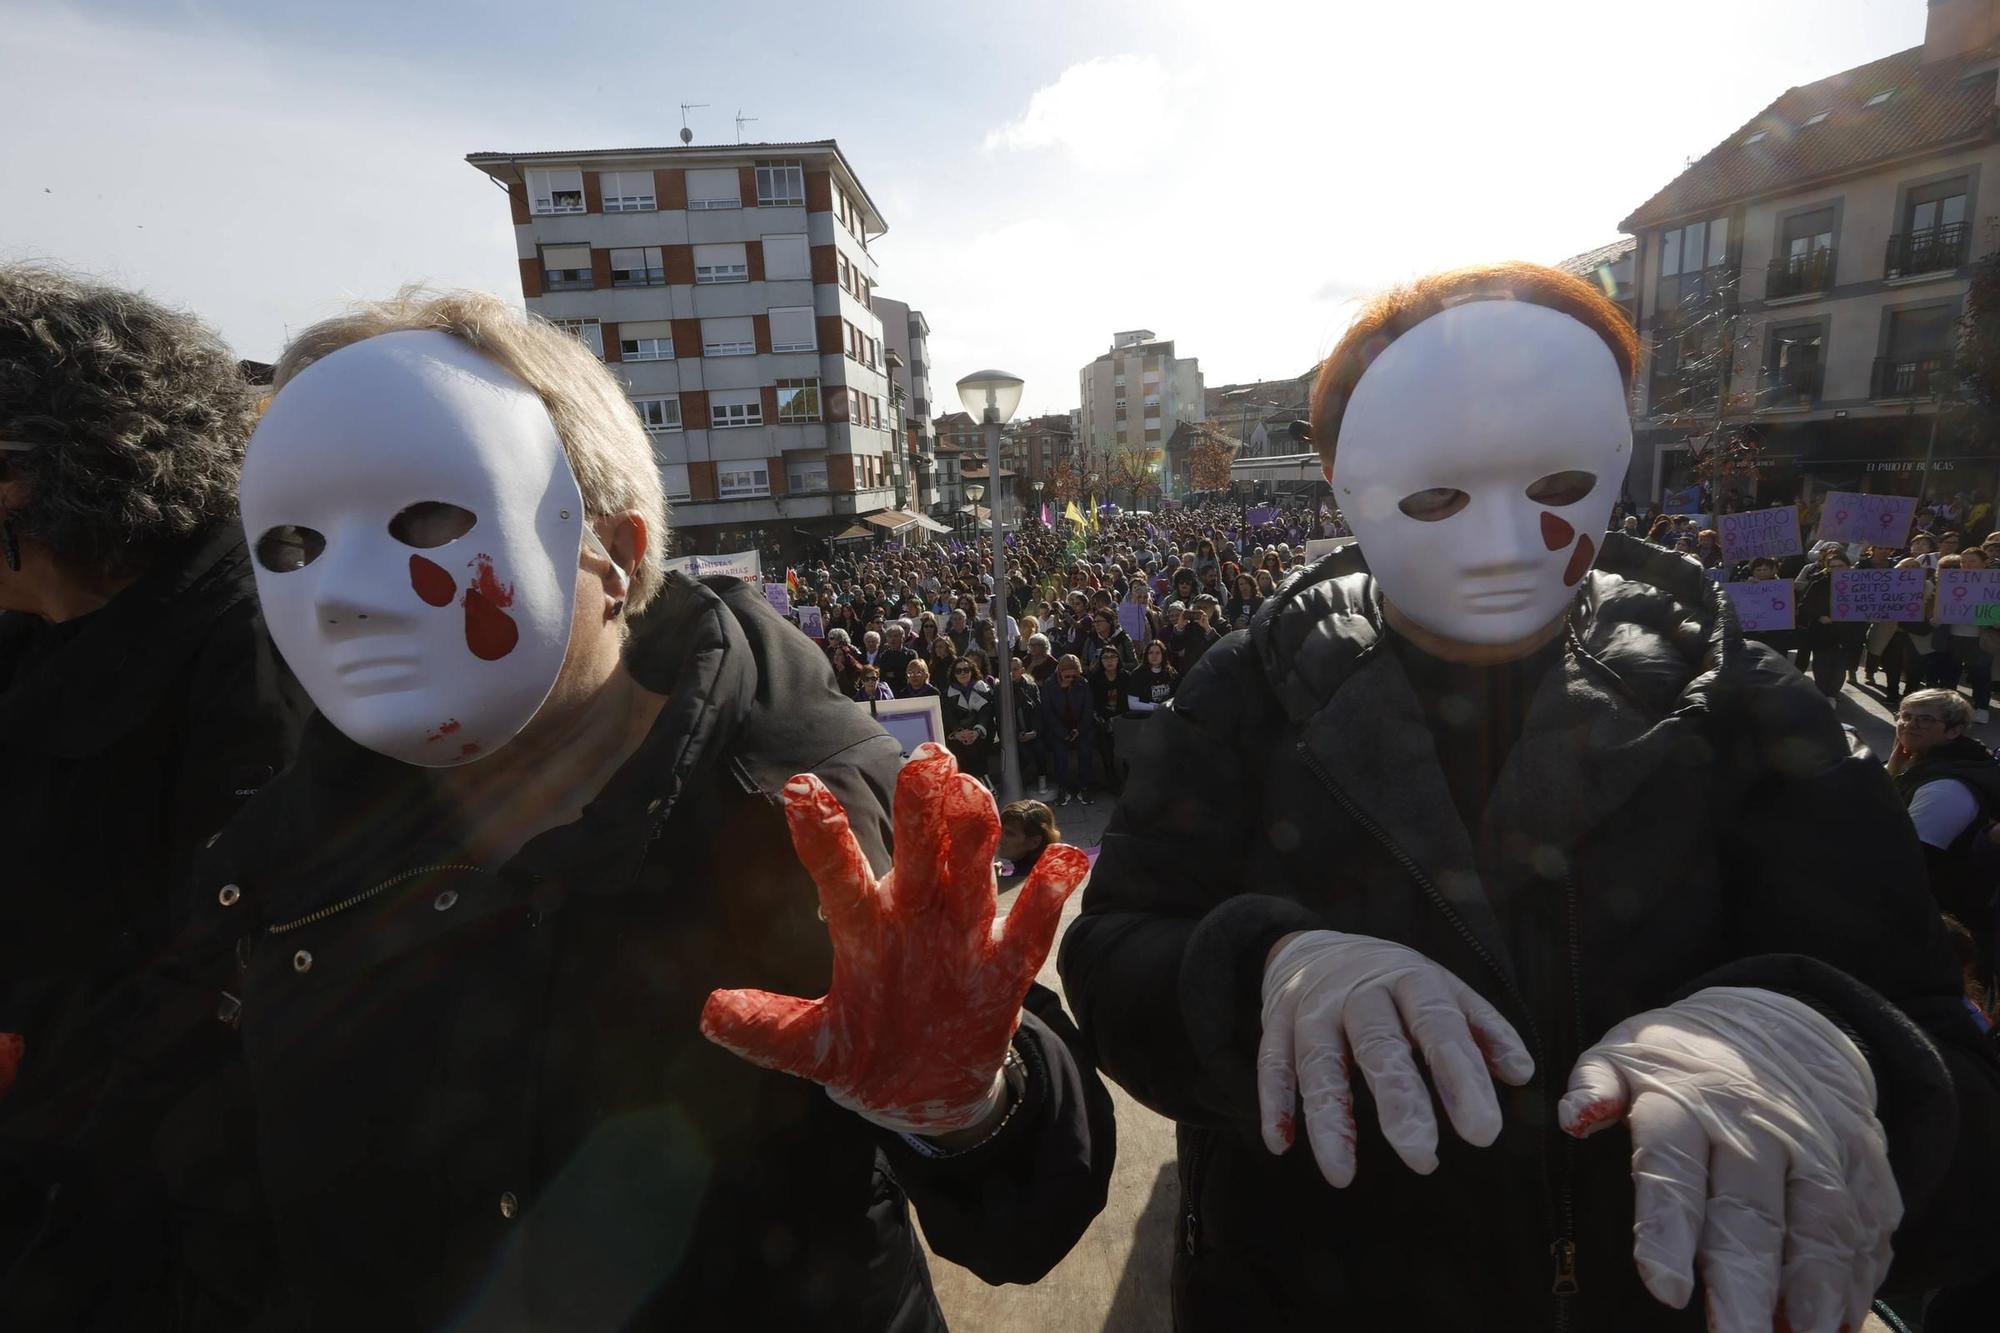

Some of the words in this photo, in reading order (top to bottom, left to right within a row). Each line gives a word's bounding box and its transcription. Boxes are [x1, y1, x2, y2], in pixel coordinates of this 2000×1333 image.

[1724, 509, 1789, 531] QUIERO
[1742, 526, 1782, 543] VIVIR
[1727, 543, 1750, 560] SIN
[684, 560, 732, 571] FEMINISTAS
[1841, 571, 1892, 582] SOMOS
[1899, 571, 1916, 582] EL
[1949, 571, 1981, 584] SIN
[1851, 582, 1890, 593] GRITO
[1854, 593, 1875, 602] LAS
[1881, 592, 1904, 601] QUE
[1910, 592, 1924, 601] YA
[1856, 604, 1869, 612] NO
